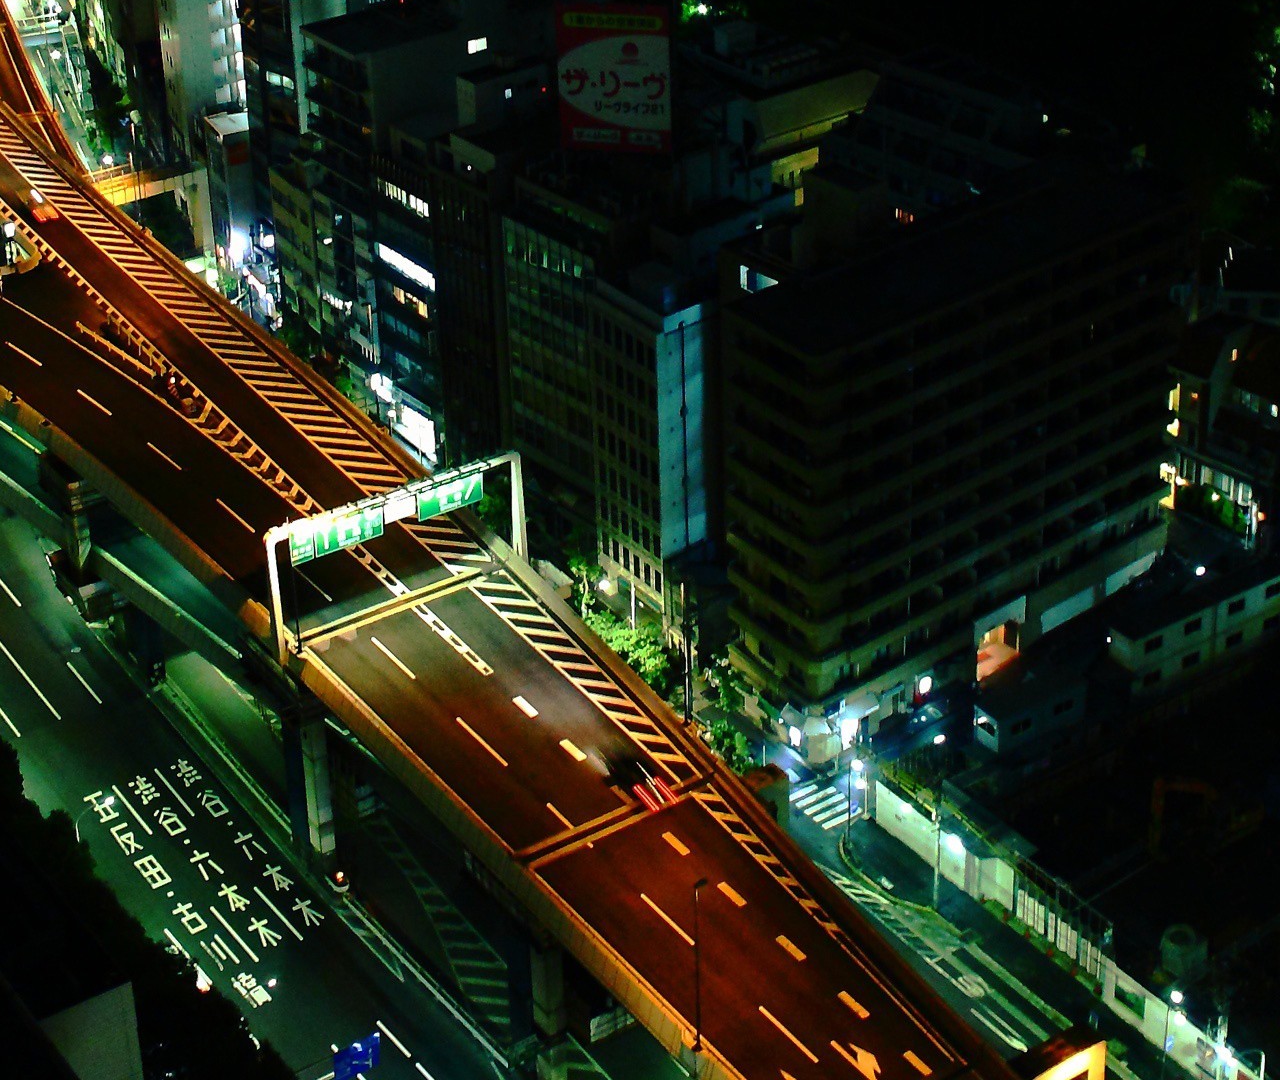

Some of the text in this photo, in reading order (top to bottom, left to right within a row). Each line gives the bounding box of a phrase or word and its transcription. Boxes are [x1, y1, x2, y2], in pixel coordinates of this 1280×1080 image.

[127, 774, 283, 948] 渋谷・六本木
[170, 758, 325, 927] 渋谷・六本木
